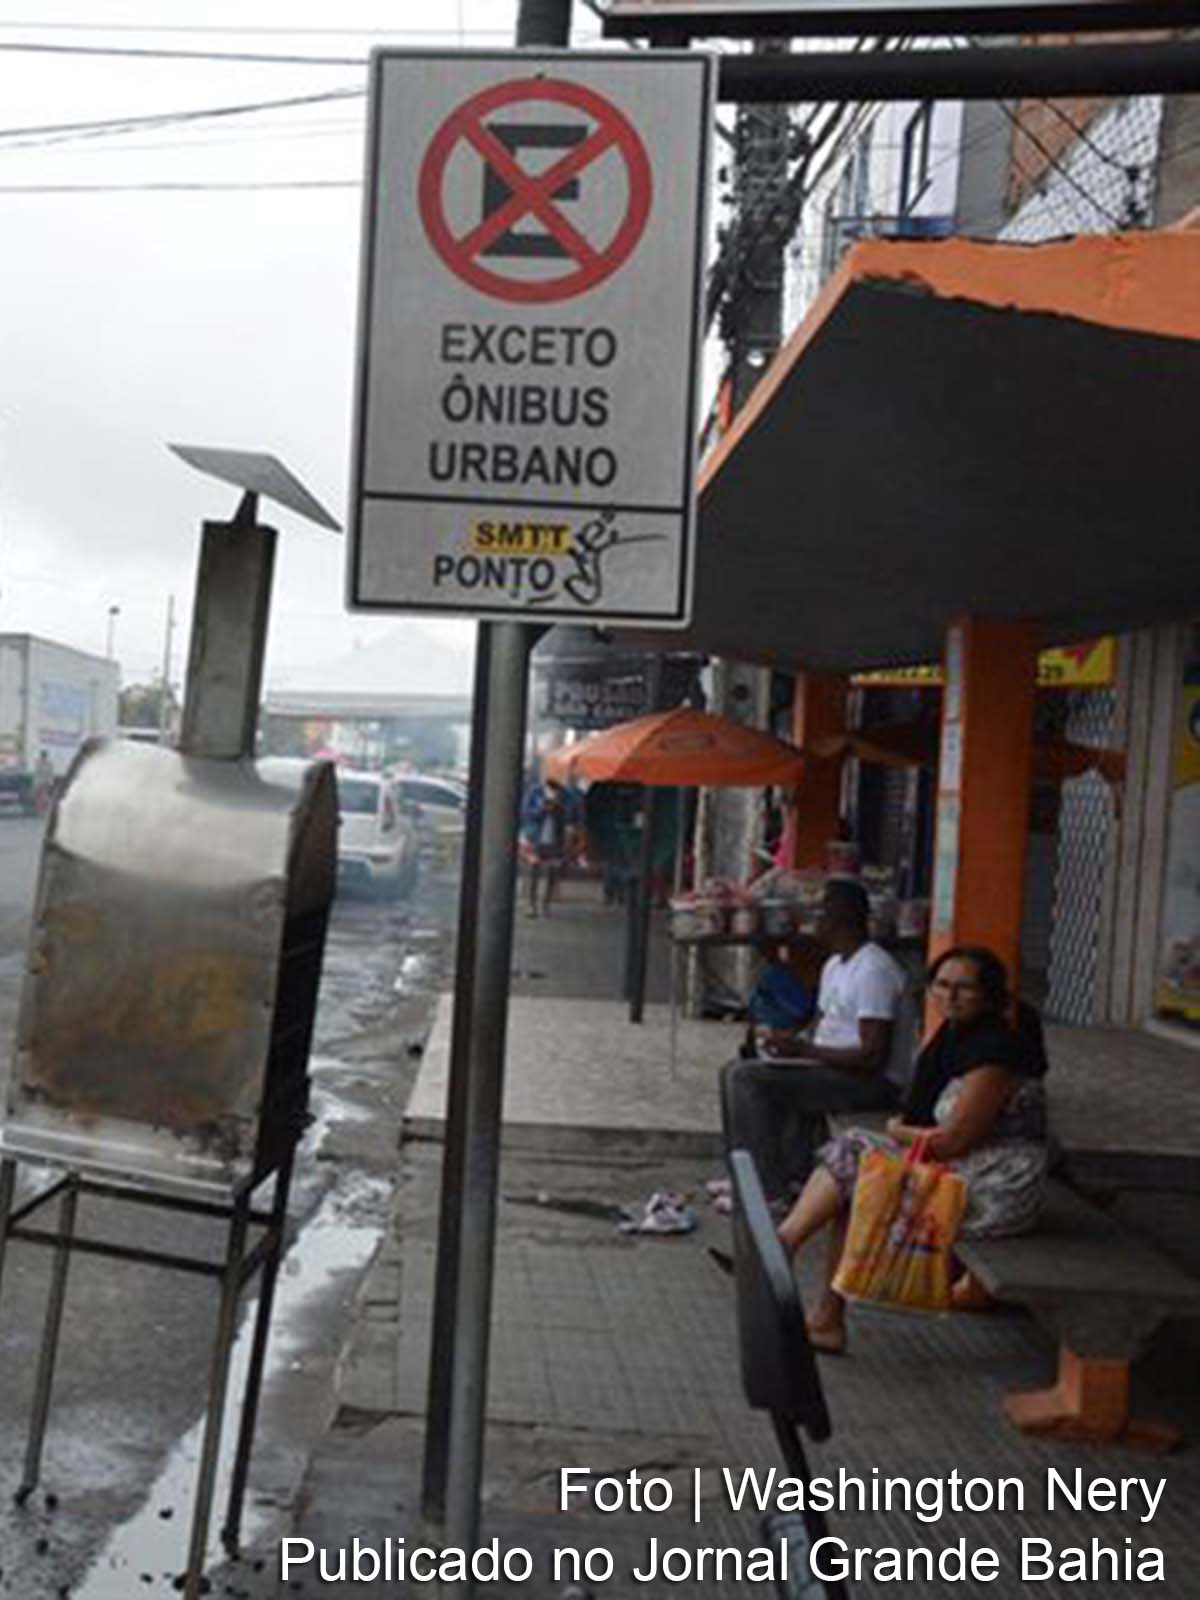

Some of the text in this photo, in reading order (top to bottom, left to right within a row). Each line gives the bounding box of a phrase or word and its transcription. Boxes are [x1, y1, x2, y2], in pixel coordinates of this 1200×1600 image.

[440, 324, 617, 367] EXCETO
[441, 373, 609, 427] ÔNIBUS
[429, 442, 617, 487] URBANO
[476, 522, 570, 549] SMTT
[433, 555, 555, 591] PONTO
